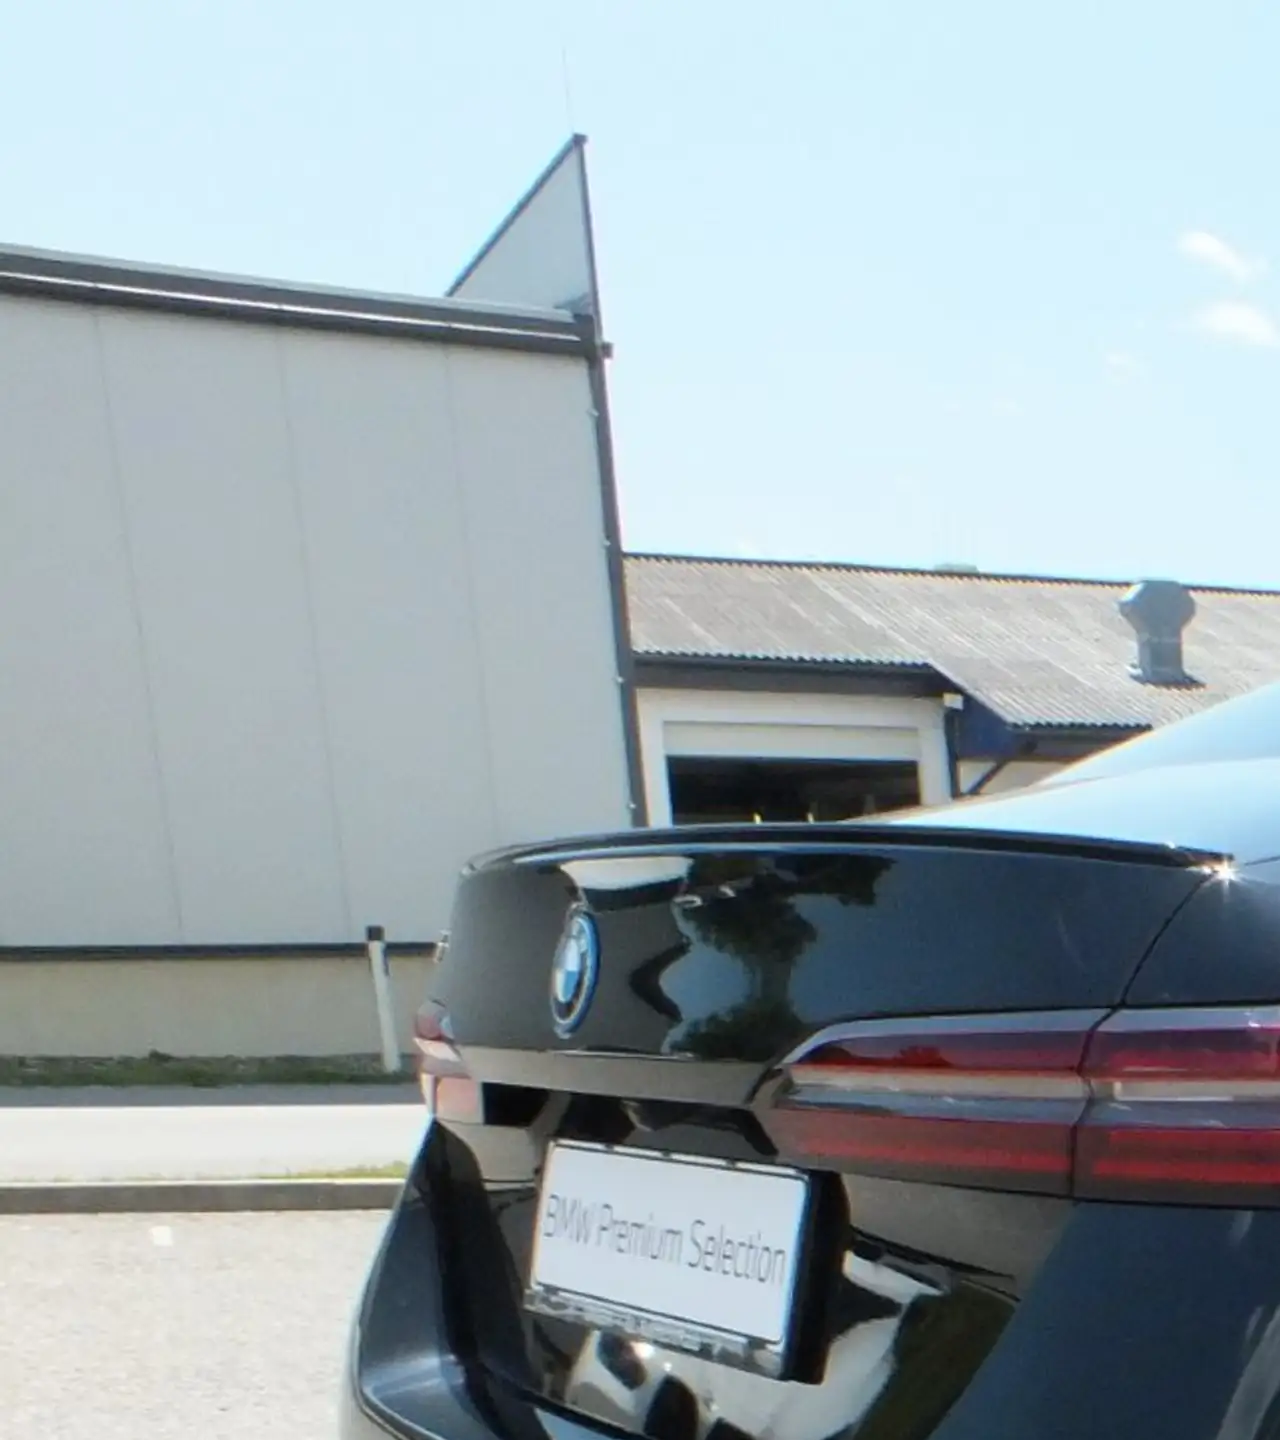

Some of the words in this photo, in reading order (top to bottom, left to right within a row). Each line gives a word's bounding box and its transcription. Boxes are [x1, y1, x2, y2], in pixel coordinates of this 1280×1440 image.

[544, 1194, 592, 1246] BMW
[595, 1203, 683, 1265] Premium
[687, 1219, 786, 1286] Selection
